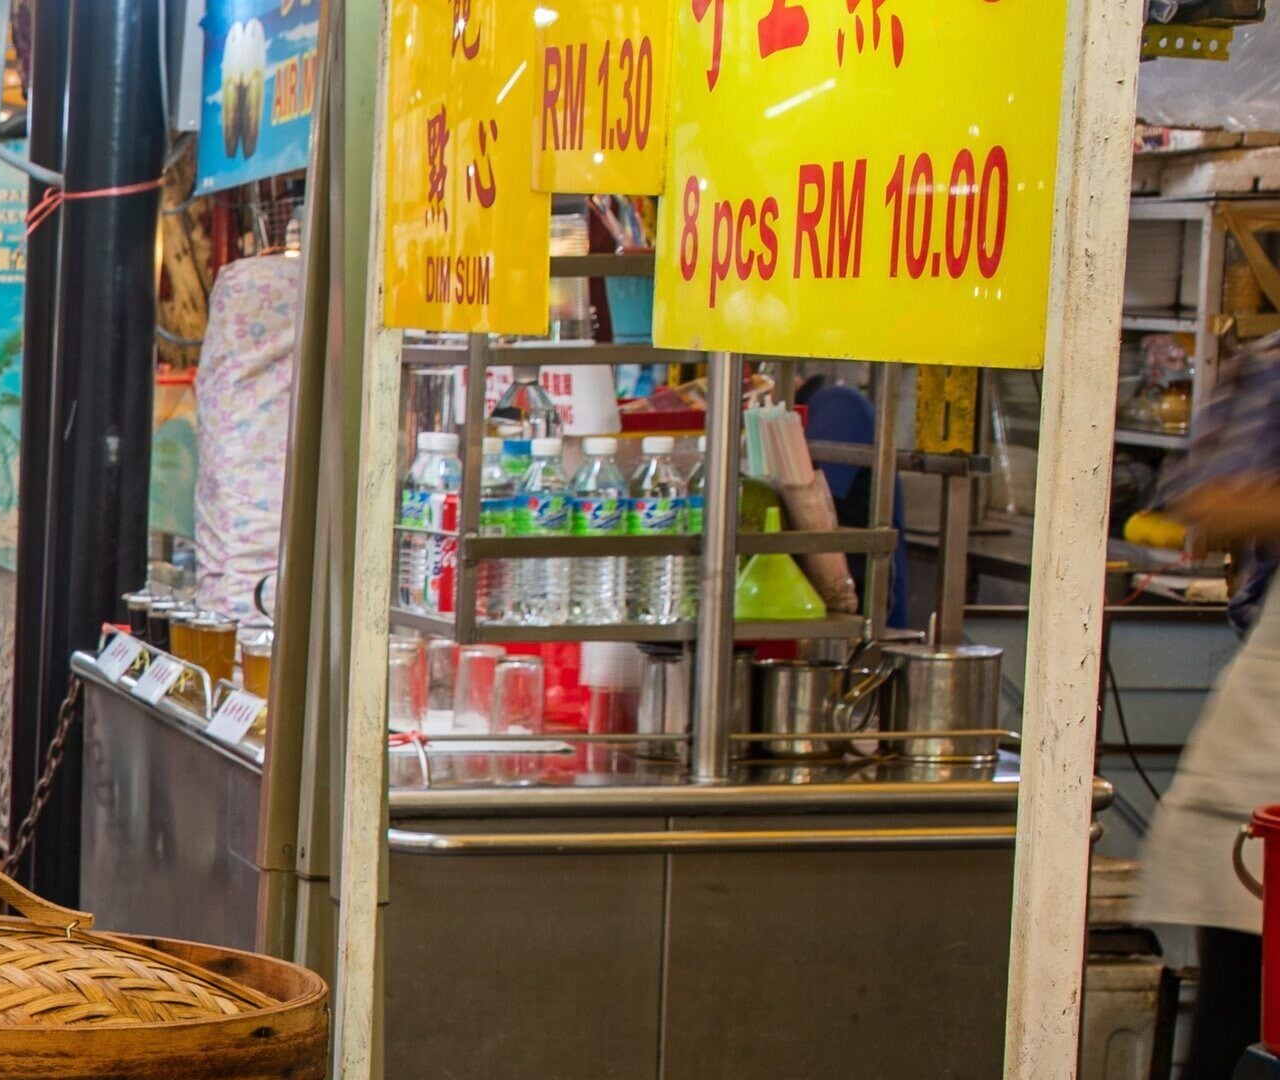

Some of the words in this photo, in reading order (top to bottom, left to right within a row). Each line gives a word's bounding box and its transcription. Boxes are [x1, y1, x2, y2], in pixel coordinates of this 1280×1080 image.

[541, 43, 587, 151] RM
[597, 36, 653, 152] 1.30
[425, 104, 498, 232] 點心
[679, 175, 701, 282] 8
[709, 196, 780, 309] pcs
[793, 158, 867, 280] RM
[885, 145, 1009, 280] 10.00
[425, 256, 450, 304] DIM
[455, 255, 490, 306] SUM
